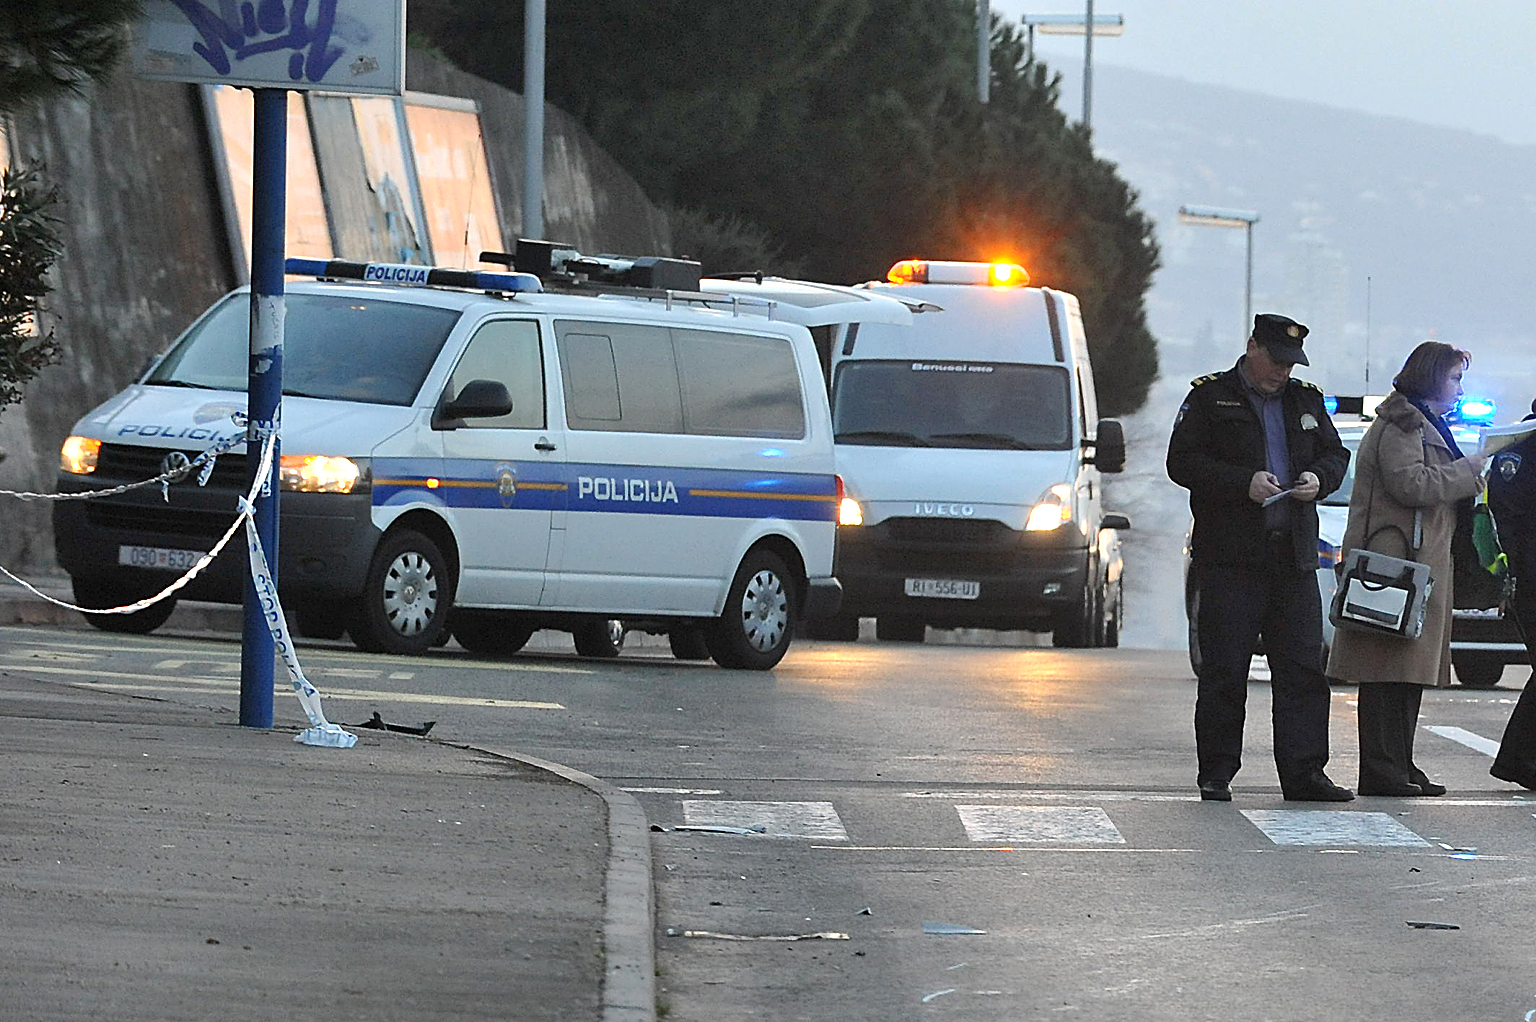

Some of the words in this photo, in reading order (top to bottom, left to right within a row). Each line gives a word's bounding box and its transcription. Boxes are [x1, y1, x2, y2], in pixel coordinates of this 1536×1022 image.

[366, 266, 426, 283] POLICIJA
[578, 476, 679, 503] POLICIJA
[915, 503, 974, 516] IVECO
[131, 548, 157, 565] 090
